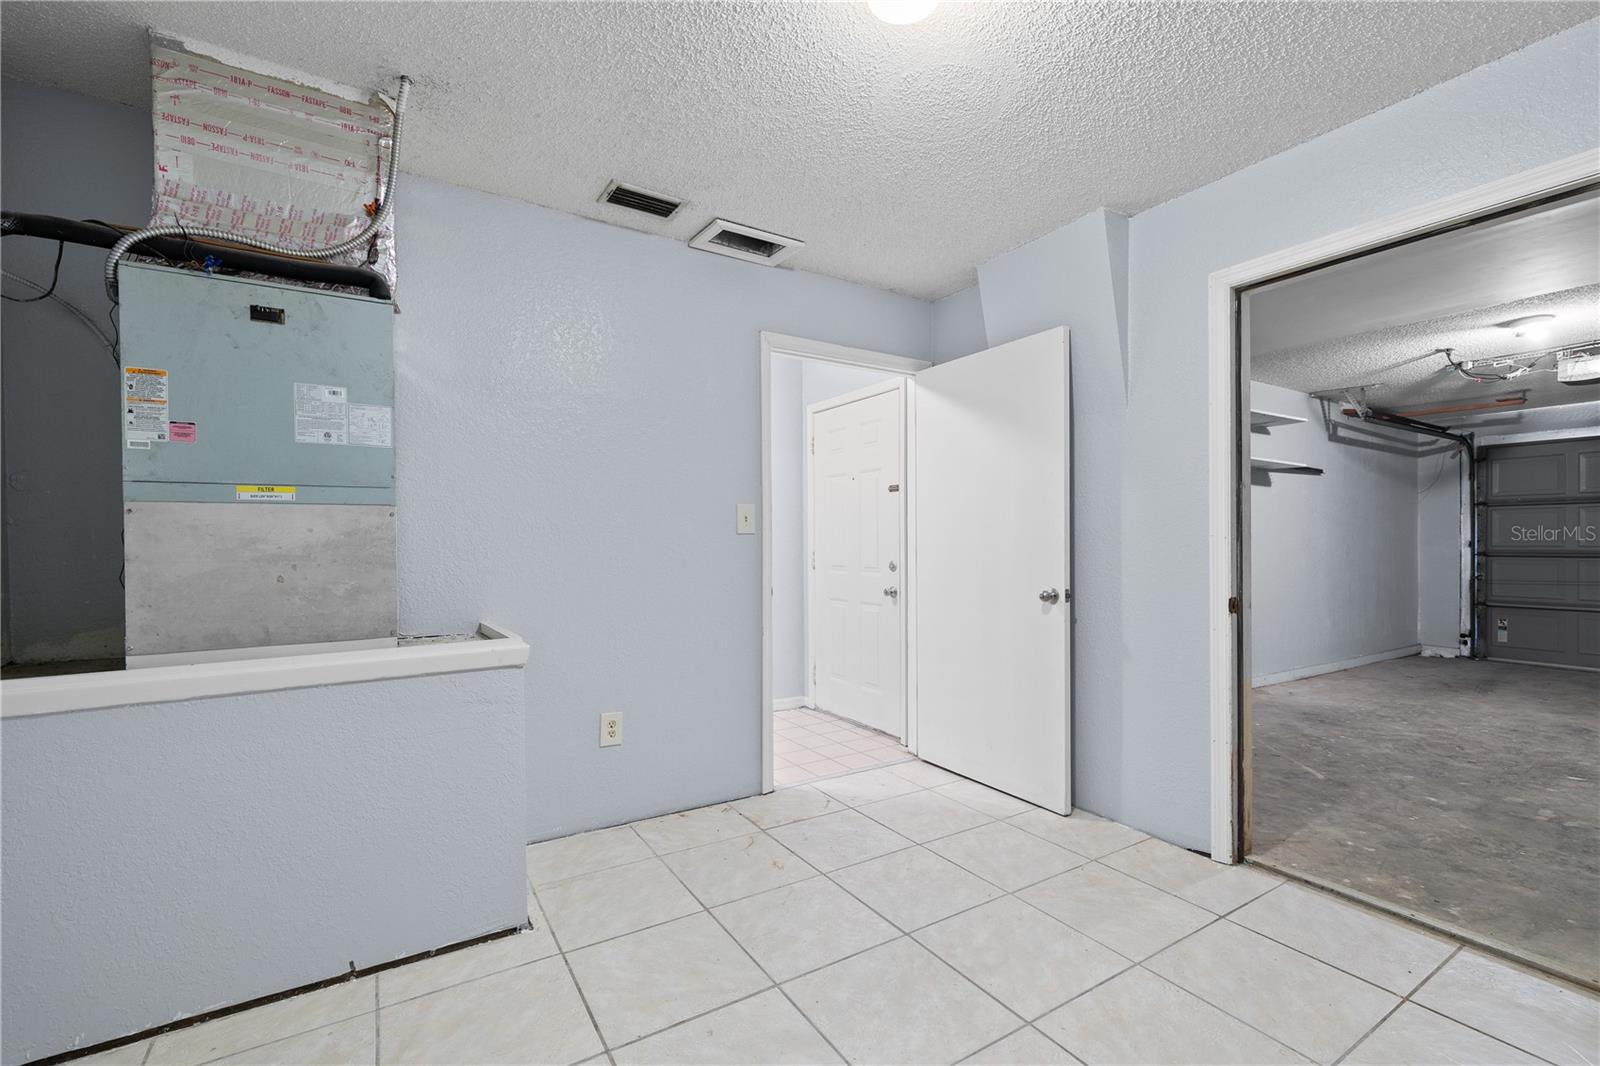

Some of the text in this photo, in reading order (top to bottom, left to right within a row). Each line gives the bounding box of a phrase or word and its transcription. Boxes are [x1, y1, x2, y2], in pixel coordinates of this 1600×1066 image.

[267, 84, 290, 98] FASSON
[301, 94, 328, 109] FASTAPE
[161, 112, 190, 127] FASTAPE
[202, 122, 228, 136] FASSON
